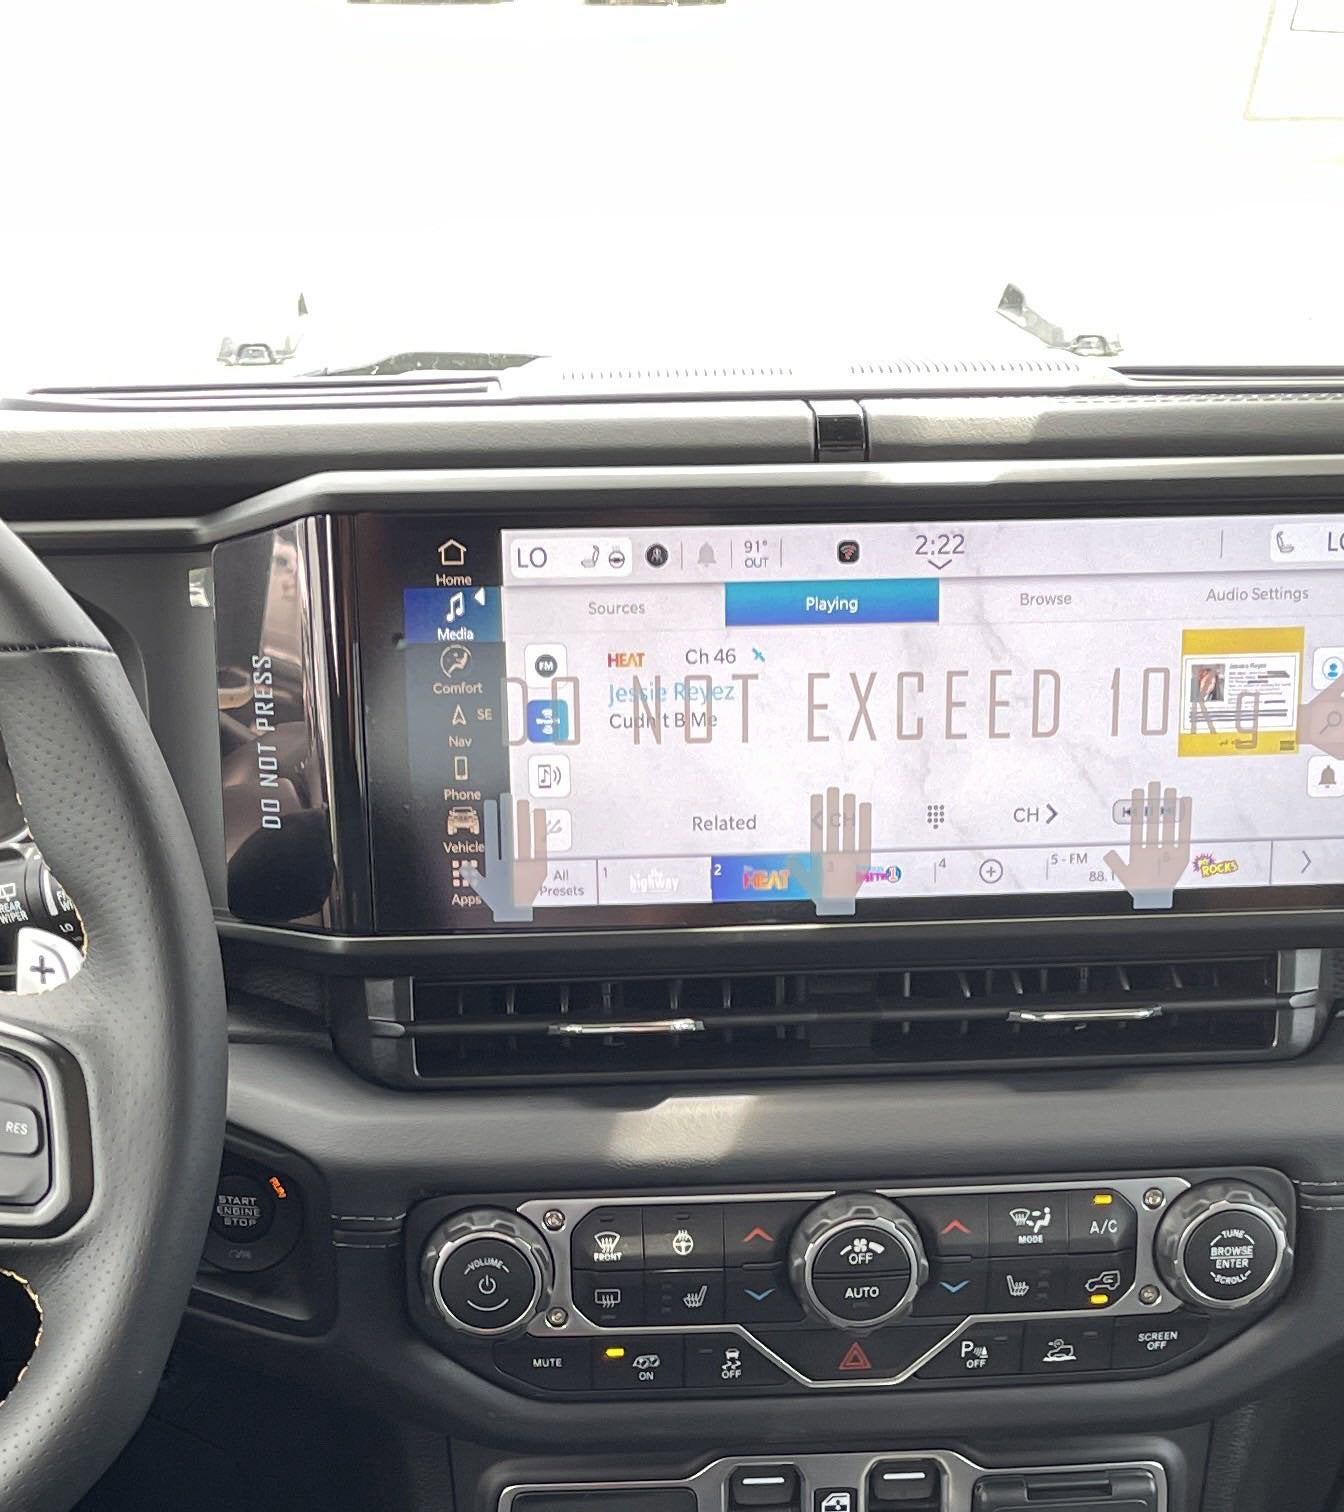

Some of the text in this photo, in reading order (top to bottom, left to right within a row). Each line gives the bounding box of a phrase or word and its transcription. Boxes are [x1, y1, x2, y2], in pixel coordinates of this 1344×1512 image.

[914, 533, 966, 555] 2:22
[517, 547, 548, 568] LO
[744, 557, 769, 569] OUT
[436, 573, 472, 586] Home
[1019, 592, 1072, 607] Browse
[1206, 586, 1309, 604] Audio Settings
[588, 601, 646, 615] Sources
[806, 596, 859, 614] Playing
[437, 627, 475, 641] Media
[607, 652, 646, 668] HEAT
[685, 648, 737, 664] Ch 46
[432, 681, 484, 694] Comfort
[476, 708, 493, 720] SE
[500, 675, 581, 747] DO
[632, 673, 759, 745] NOT
[807, 668, 1062, 743] EXCEED
[674, 711, 687, 728] B
[691, 711, 718, 728] Me
[251, 655, 282, 830] DO NOT PRESS
[447, 735, 473, 749] Nav
[443, 788, 481, 801] Phone
[1012, 807, 1040, 823] CH
[692, 814, 757, 832] Related
[443, 841, 485, 854] Vehicle
[938, 858, 947, 869] 4
[1069, 853, 1088, 864] FM
[553, 869, 569, 881] All
[714, 864, 723, 876] 2
[539, 884, 585, 896] Presets
[451, 893, 482, 907] Apps
[5, 1121, 29, 1135] RES
[219, 1195, 257, 1206] START
[216, 1205, 261, 1217] ENGINE
[223, 1217, 257, 1227] STOP
[1089, 1218, 1119, 1235] A/C
[1018, 1233, 1044, 1244] MODE
[1221, 1228, 1246, 1239] TUNE
[593, 1251, 623, 1262] FRONT
[1210, 1245, 1254, 1256] BROWSE
[467, 1257, 504, 1271] VOLUME
[848, 1252, 873, 1266] OFF
[1215, 1258, 1249, 1269] ENTER
[1214, 1273, 1247, 1285] SCROLL
[845, 1286, 880, 1300] AUTO
[1138, 1330, 1179, 1343] SCREEN
[1146, 1340, 1168, 1352] OFF
[532, 1357, 563, 1369] MUTE
[966, 1358, 987, 1369] OFF
[638, 1370, 654, 1381] ON
[721, 1369, 742, 1380] OFF
